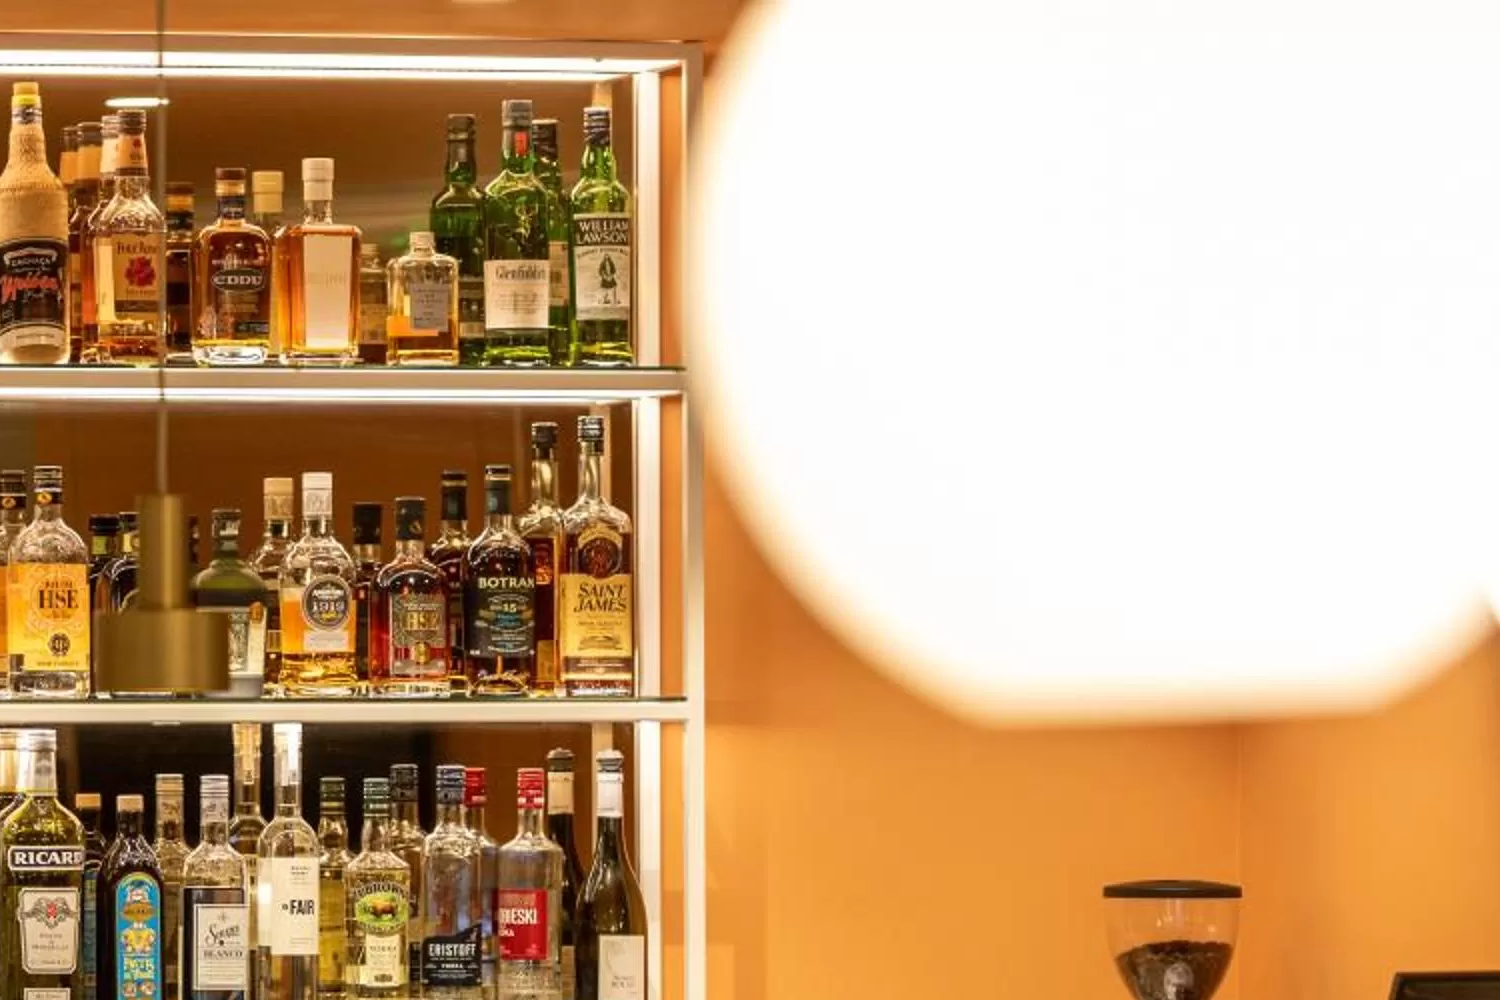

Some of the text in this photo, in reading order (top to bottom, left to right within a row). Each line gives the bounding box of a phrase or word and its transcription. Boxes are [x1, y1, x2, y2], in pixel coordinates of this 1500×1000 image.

[577, 233, 627, 245] LAWSON
[479, 576, 535, 590] BOTRAN
[579, 582, 627, 598] SAINT
[38, 589, 80, 610] HSE
[311, 601, 346, 613] 1919
[573, 597, 628, 613] JAMES
[14, 852, 85, 866] RICARD
[290, 900, 316, 917] FAIR
[428, 942, 477, 958] ERISTOFF
